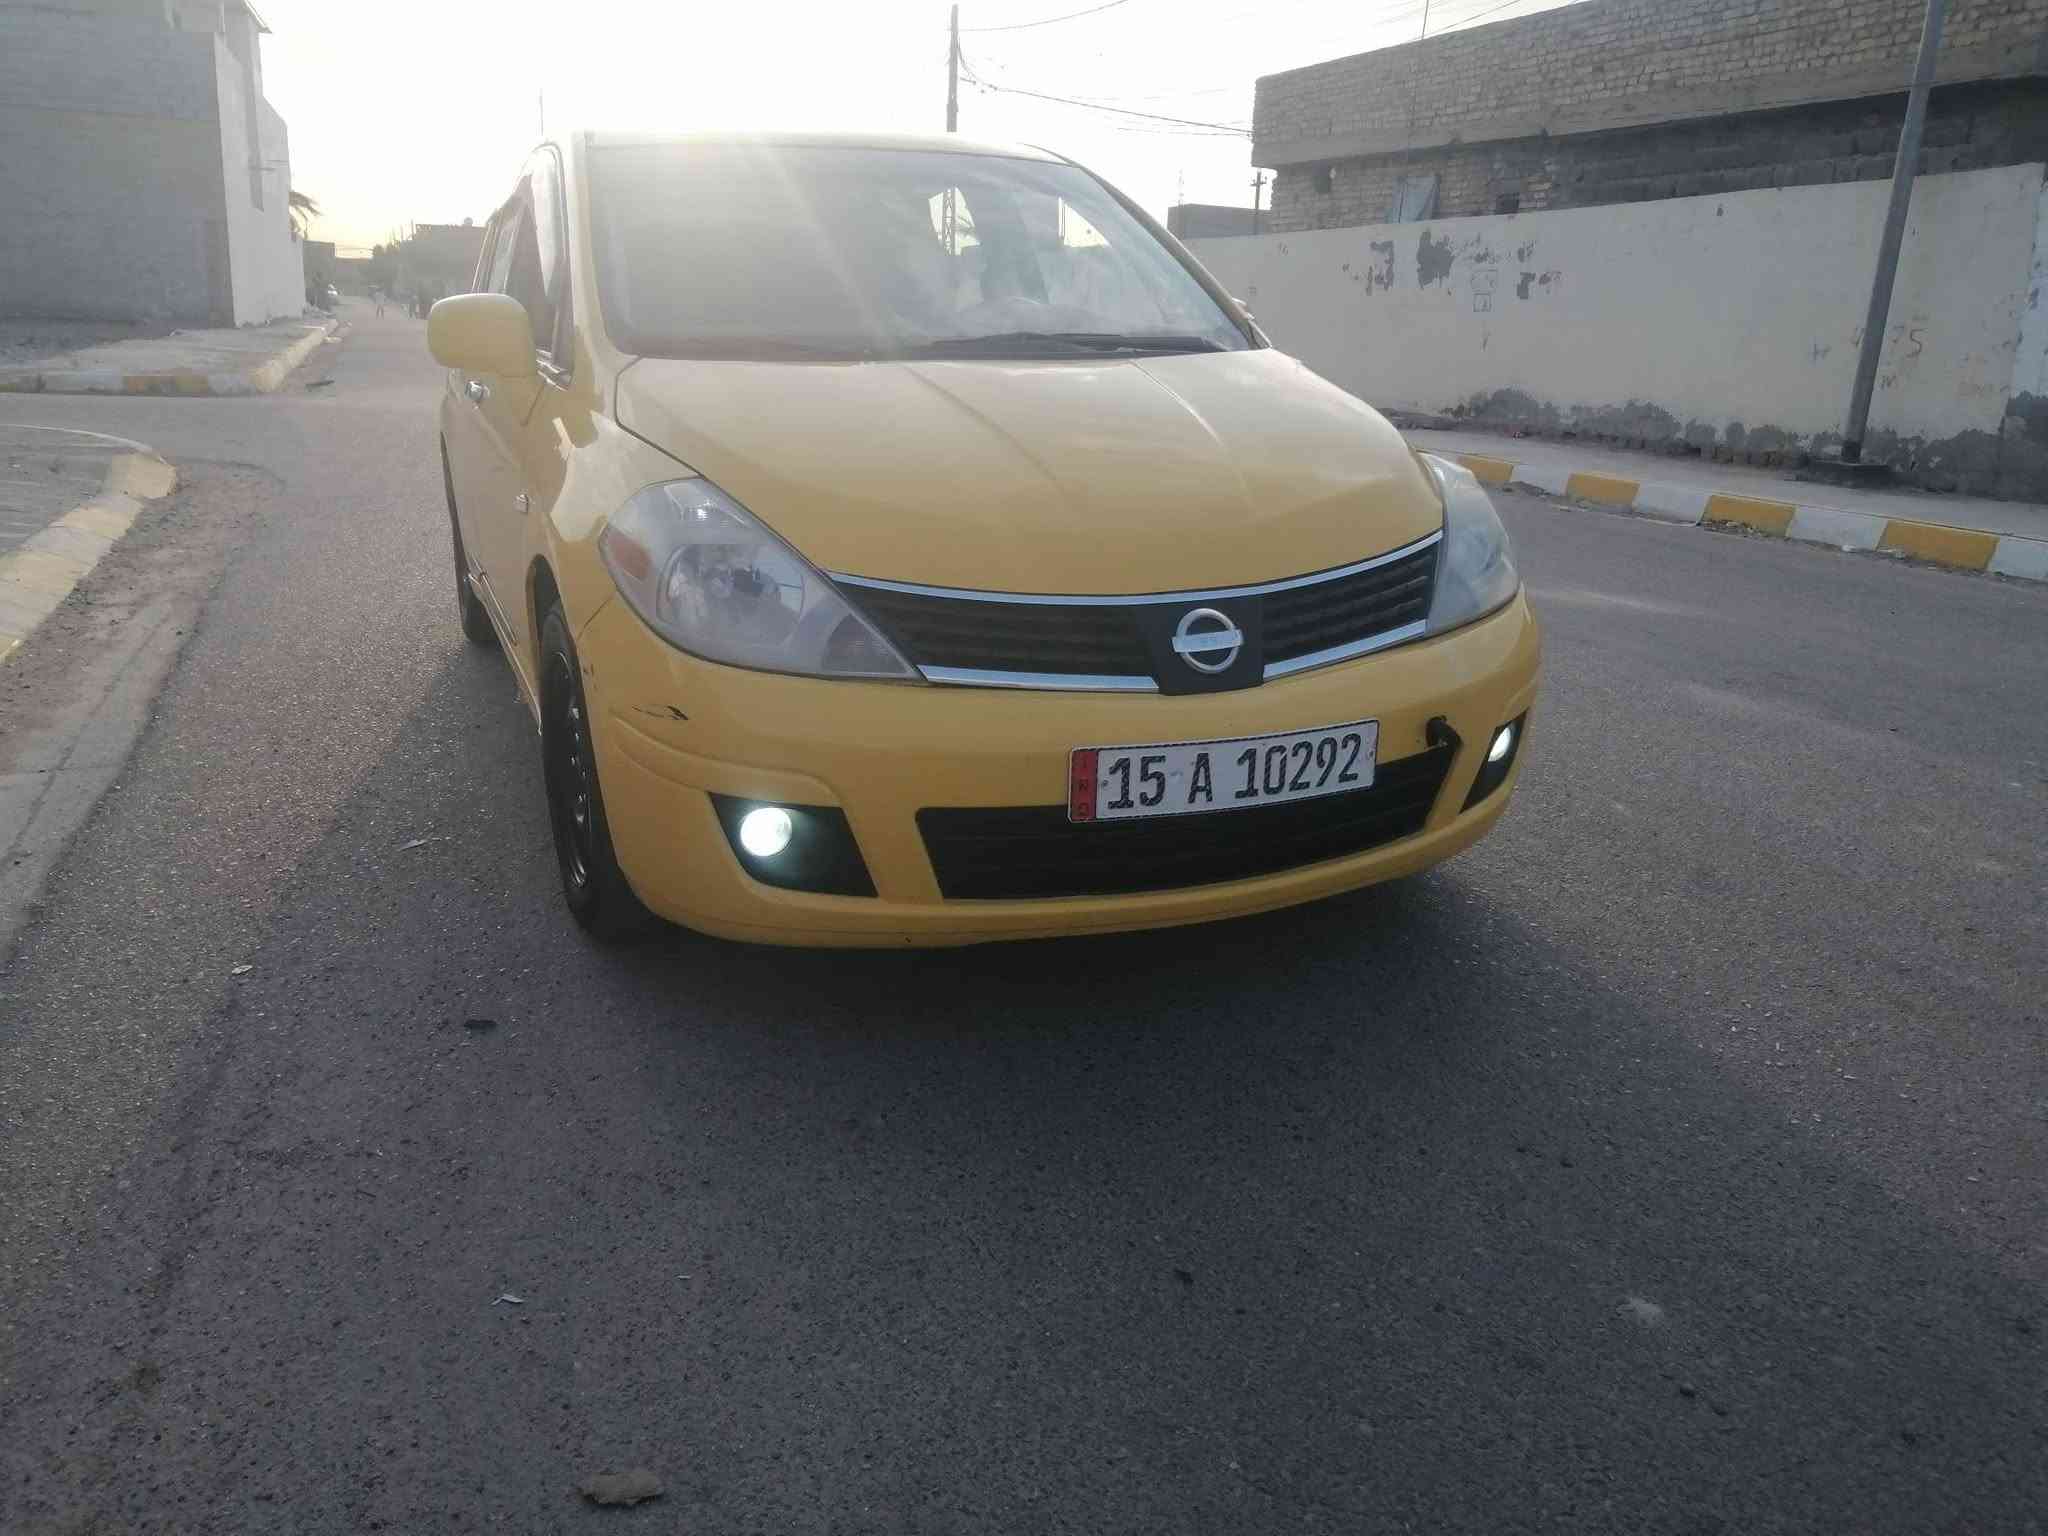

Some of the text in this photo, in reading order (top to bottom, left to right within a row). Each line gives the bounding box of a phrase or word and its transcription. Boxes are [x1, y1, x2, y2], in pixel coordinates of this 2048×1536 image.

[1107, 733, 1363, 810] 15 A 10292
